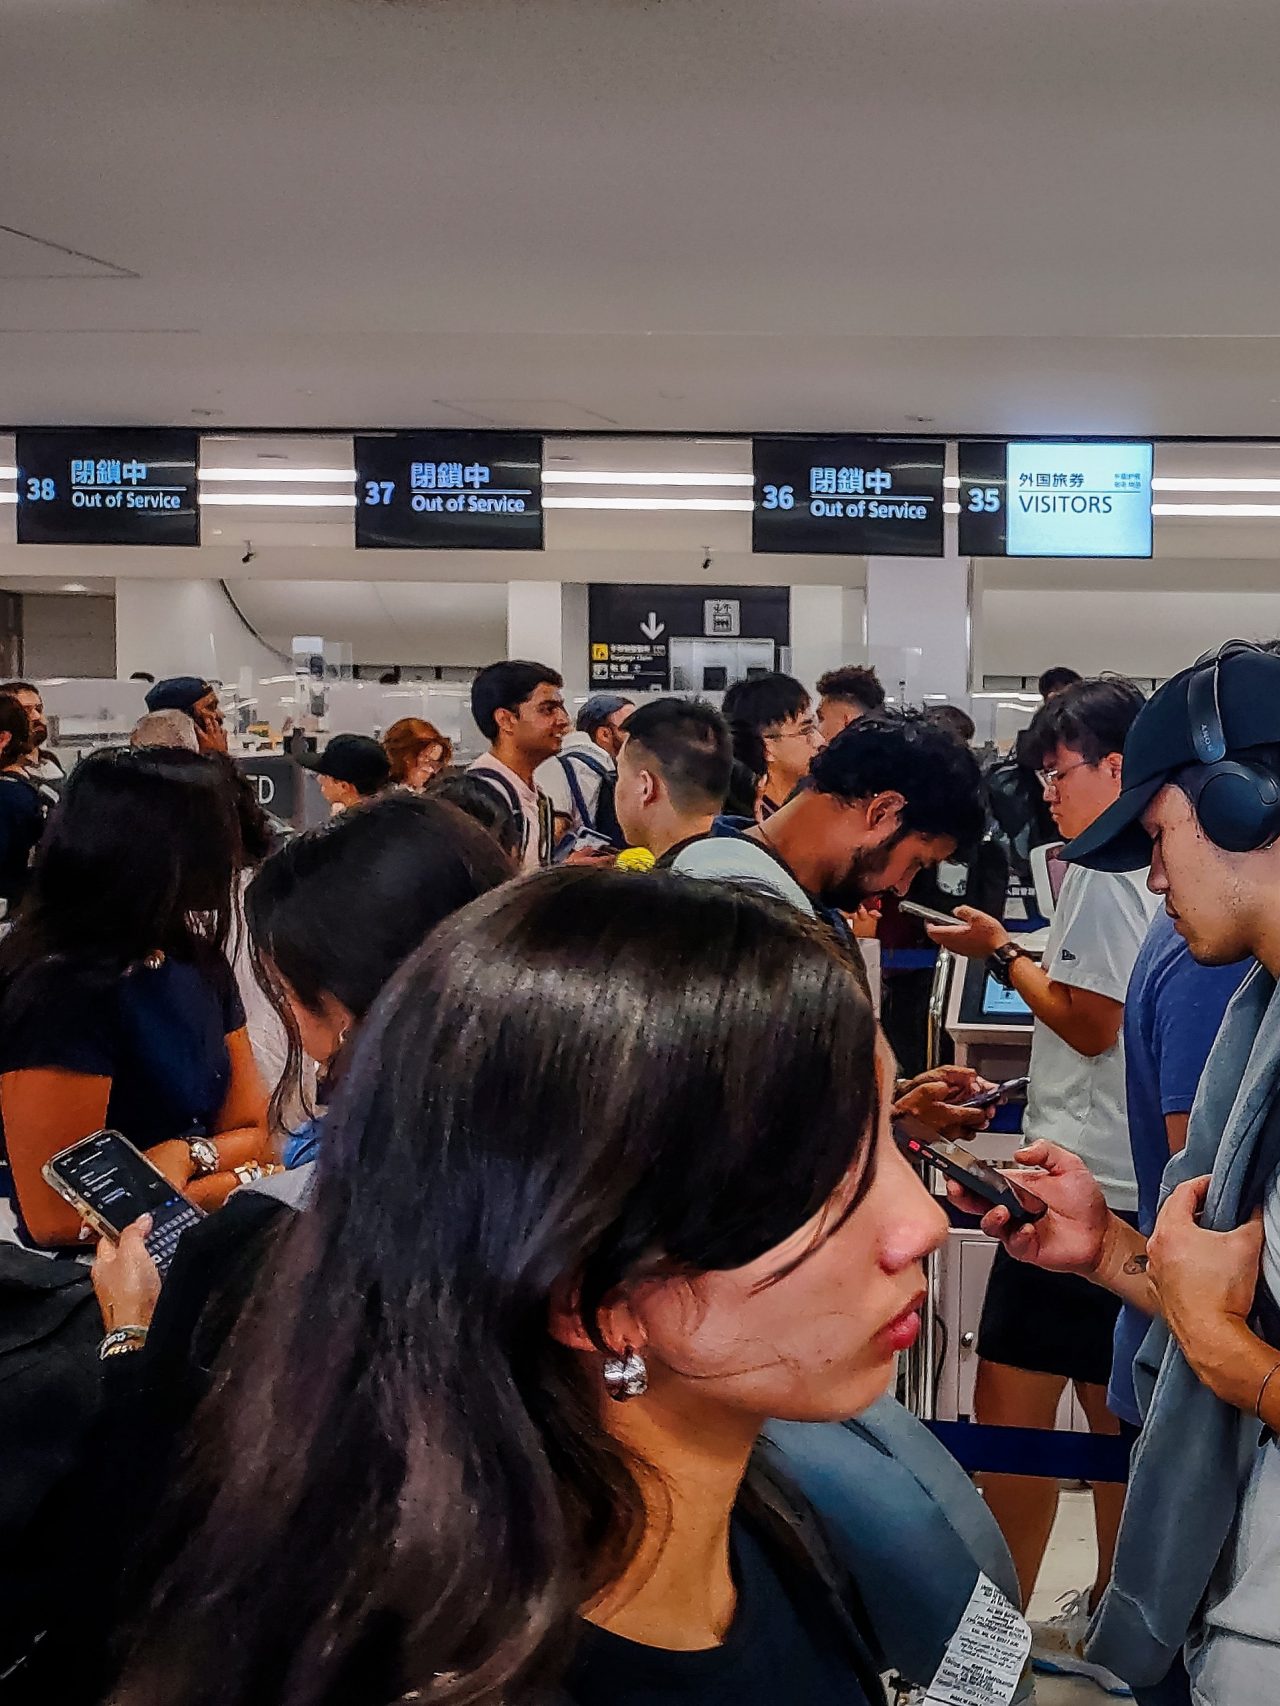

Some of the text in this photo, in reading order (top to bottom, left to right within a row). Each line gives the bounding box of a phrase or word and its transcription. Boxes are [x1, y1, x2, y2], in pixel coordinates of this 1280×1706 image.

[71, 459, 147, 485] 閉鎖中
[411, 462, 490, 488] 閉鎖中
[810, 466, 892, 494] 閉鎖中
[1018, 472, 1085, 488] 外国旅券
[26, 478, 55, 501] 38
[72, 490, 181, 509] Out of Service
[365, 481, 395, 505] 37
[762, 485, 795, 510] 36
[968, 487, 1001, 513] 35
[411, 495, 525, 513] Out of Service
[810, 499, 928, 520] Out of Service
[1018, 494, 1113, 514] VISITORS
